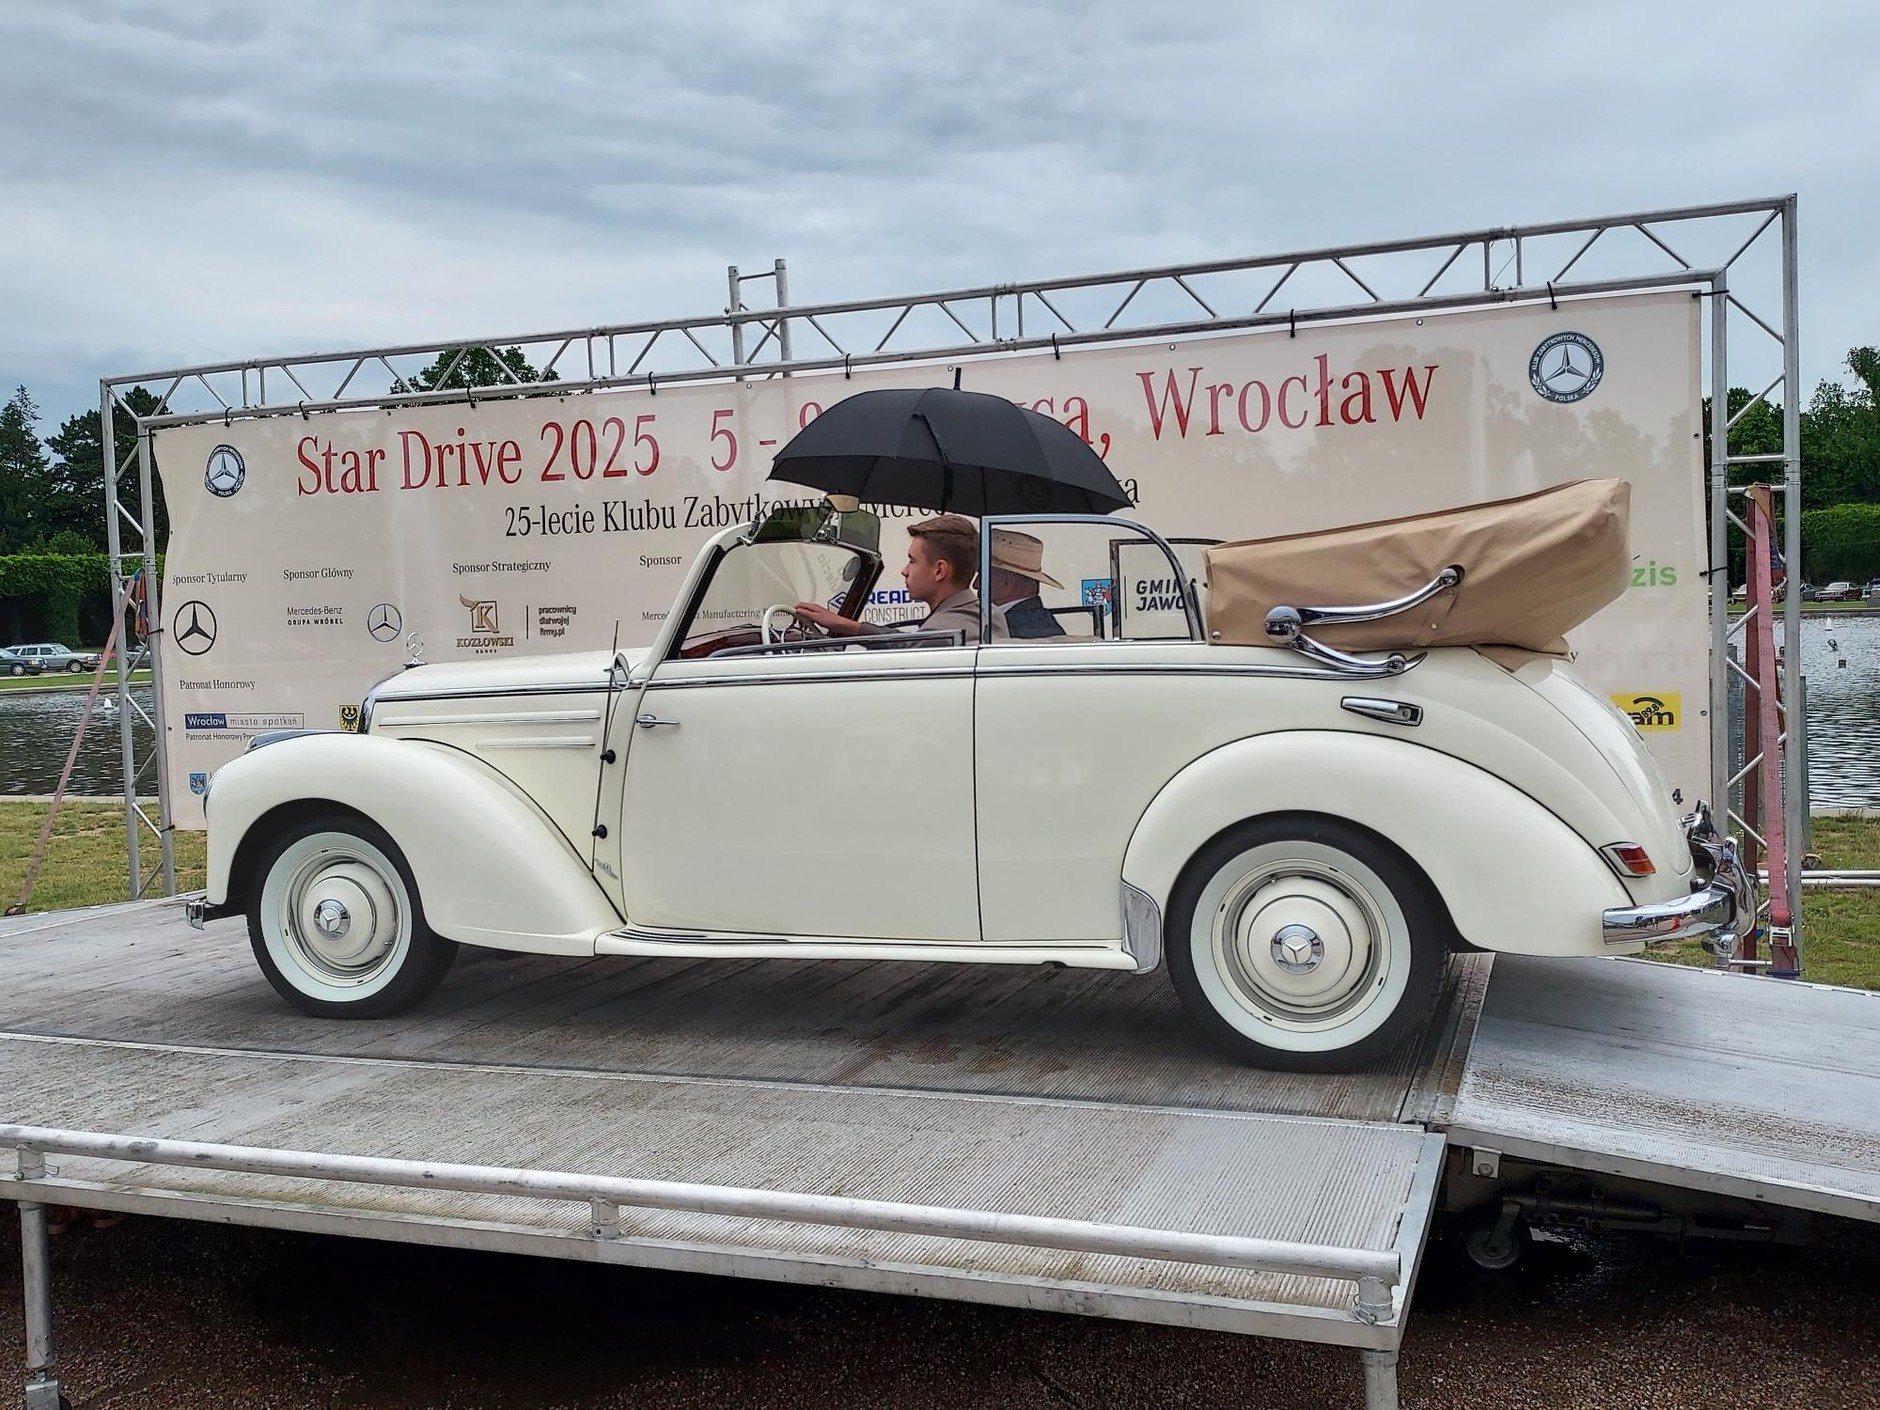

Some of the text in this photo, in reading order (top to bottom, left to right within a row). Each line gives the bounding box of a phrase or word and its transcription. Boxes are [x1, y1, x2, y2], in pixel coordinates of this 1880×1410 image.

[297, 435, 386, 496] Star
[397, 427, 523, 490] Drive
[540, 414, 660, 482] 2025
[710, 409, 738, 472] 5
[1135, 353, 1440, 442] Wrocław
[505, 503, 595, 537] 25-lecie
[602, 498, 677, 533] Klubu
[683, 492, 823, 527] Zabytkowy
[452, 560, 552, 575] Sponsor Strategiczny
[639, 555, 683, 568] Sponsor
[172, 571, 248, 587] Sponsor Tytularny
[283, 567, 354, 582] Sponsor Główny
[867, 589, 923, 604] READ
[1136, 596, 1186, 612] JAWO
[286, 606, 343, 617] Mercedes-Benz
[702, 609, 761, 619] Manufacturing
[864, 606, 927, 623] CONSTRUCT
[456, 637, 514, 648] KOZŁOWSKI
[179, 679, 256, 691] Patronat Honorowy
[230, 717, 259, 727] miasto
